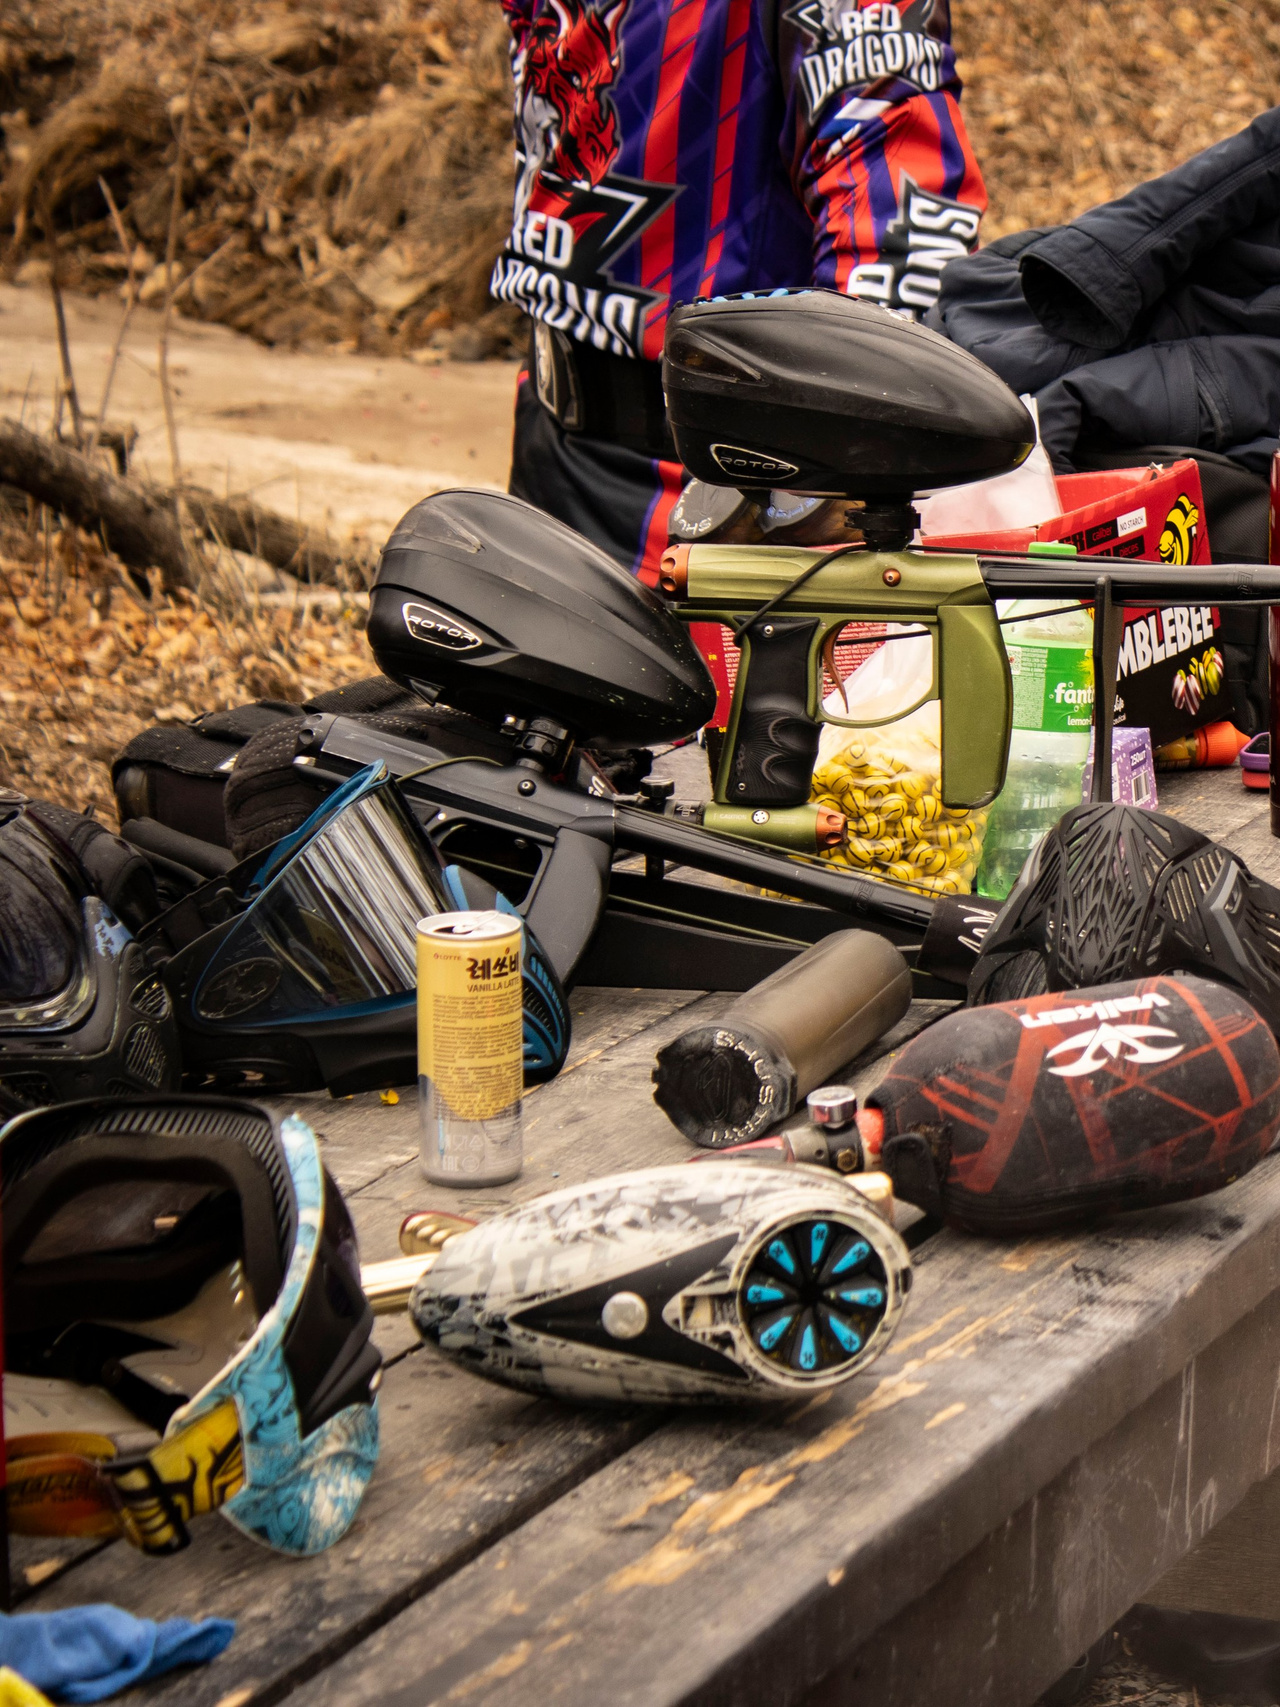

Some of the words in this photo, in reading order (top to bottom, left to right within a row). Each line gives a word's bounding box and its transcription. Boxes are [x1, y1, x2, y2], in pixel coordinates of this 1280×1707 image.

[841, 3, 901, 41] RED
[803, 32, 940, 113] DRAGONS
[720, 456, 791, 472] ROTOR
[1092, 526, 1112, 541] caliber
[1120, 523, 1127, 531] NO
[1128, 516, 1143, 528] STARCH
[407, 615, 476, 642] ROTOR
[1116, 606, 1214, 681] MBLEBEE
[1055, 683, 1094, 703] fant
[466, 951, 519, 980] 레쓰비
[467, 982, 502, 993] VANILLA
[504, 976, 520, 988] LATTE
